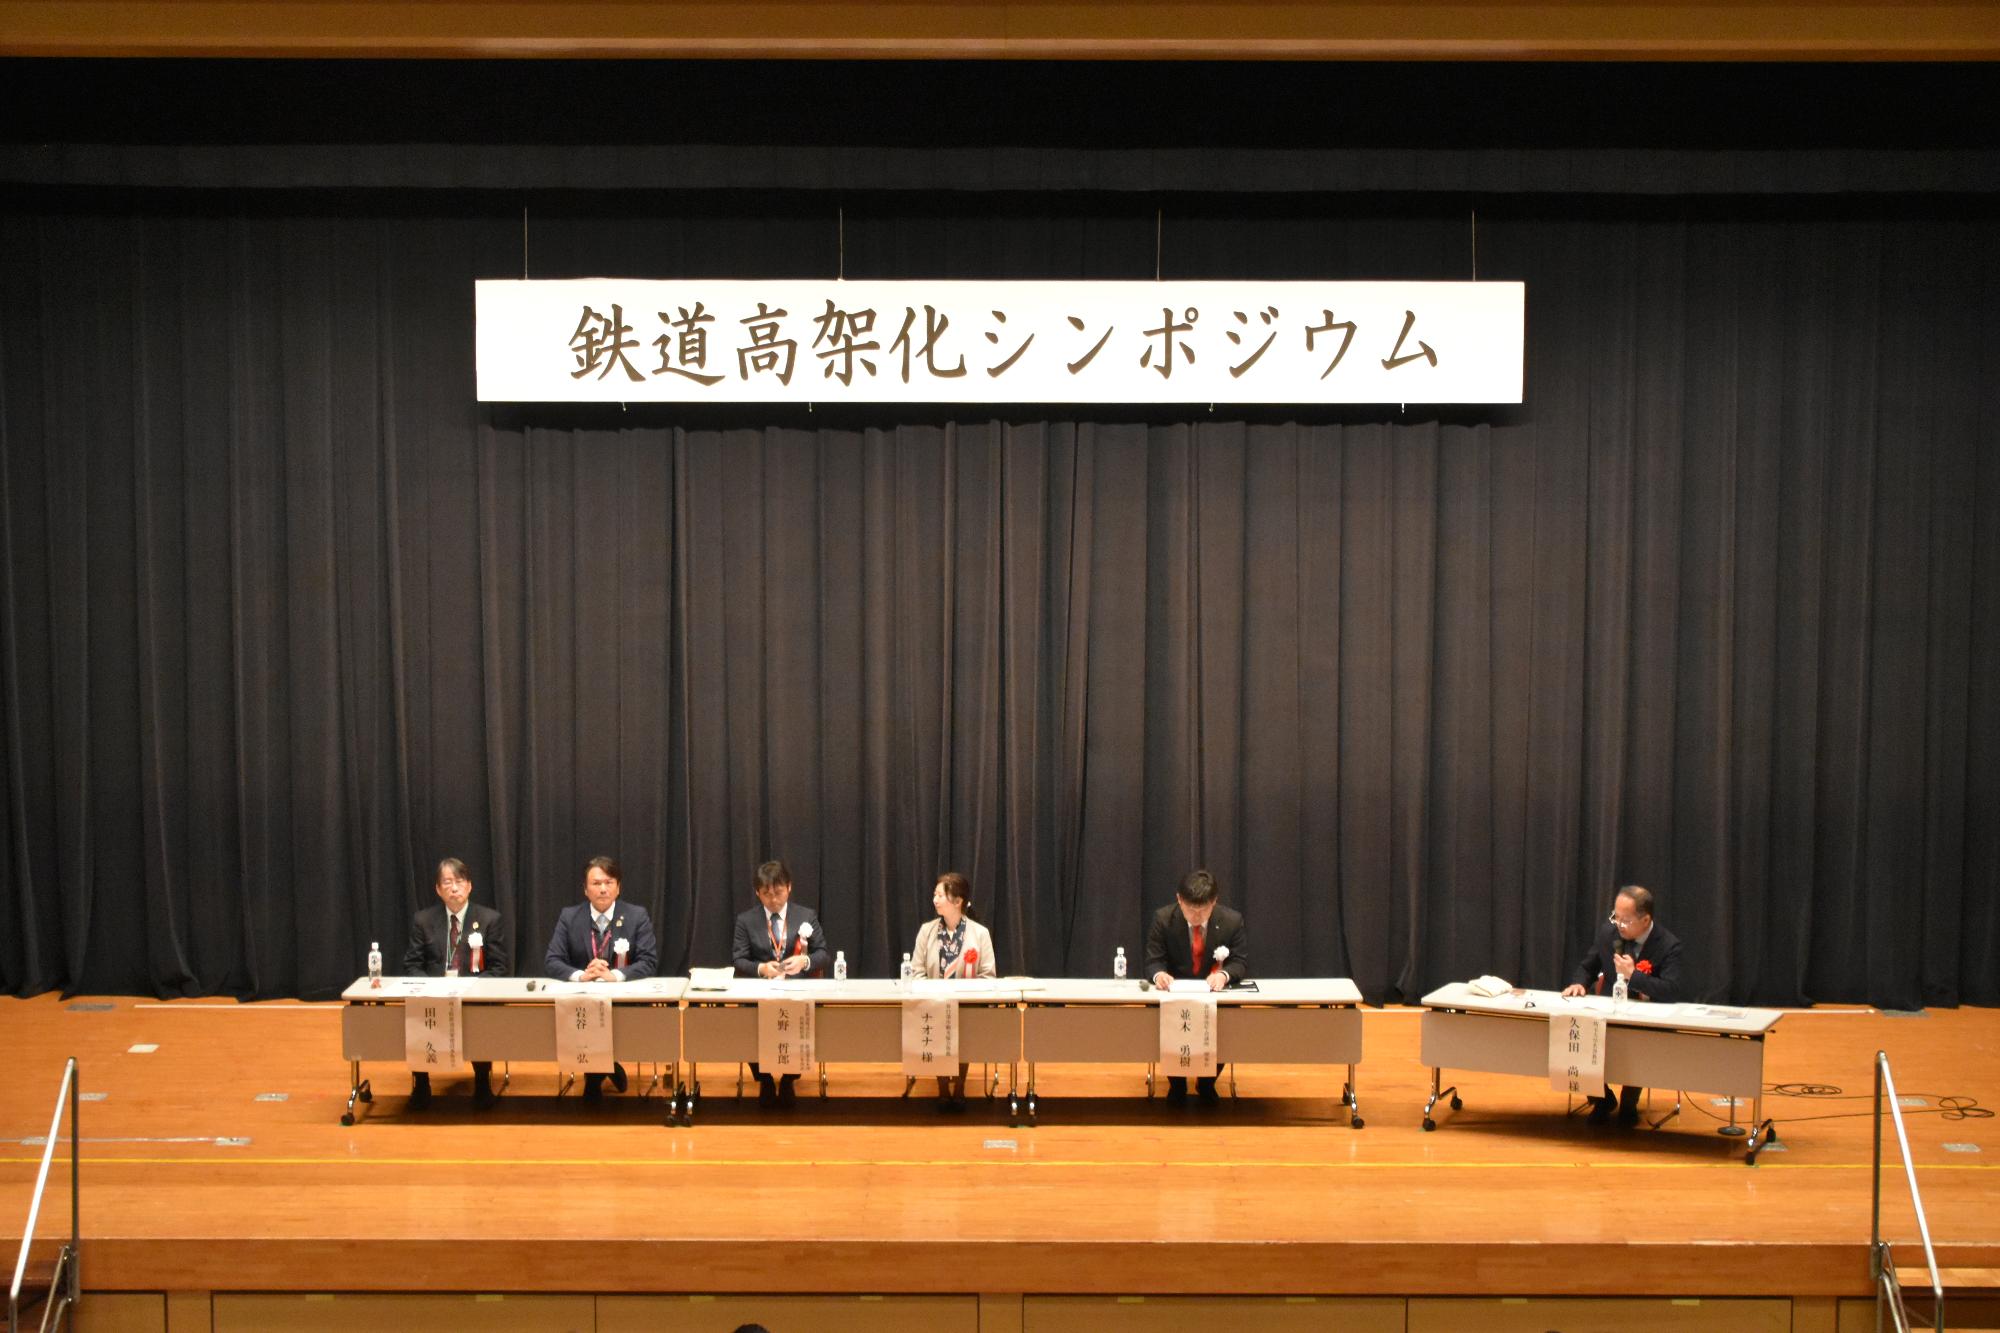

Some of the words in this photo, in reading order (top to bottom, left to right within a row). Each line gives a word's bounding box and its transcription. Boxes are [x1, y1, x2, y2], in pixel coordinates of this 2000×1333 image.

[569, 299, 1437, 386] 鉄道高架化シンポジウム
[424, 1007, 436, 1031] 田中
[575, 1007, 587, 1030] 岩谷
[777, 1007, 790, 1032] 矢野
[921, 1012, 933, 1048] ナオナ
[1180, 1009, 1191, 1032] 並木
[1568, 1016, 1580, 1053] 久保田
[777, 1042, 790, 1065] 哲郎
[1179, 1044, 1191, 1067] 勇樹
